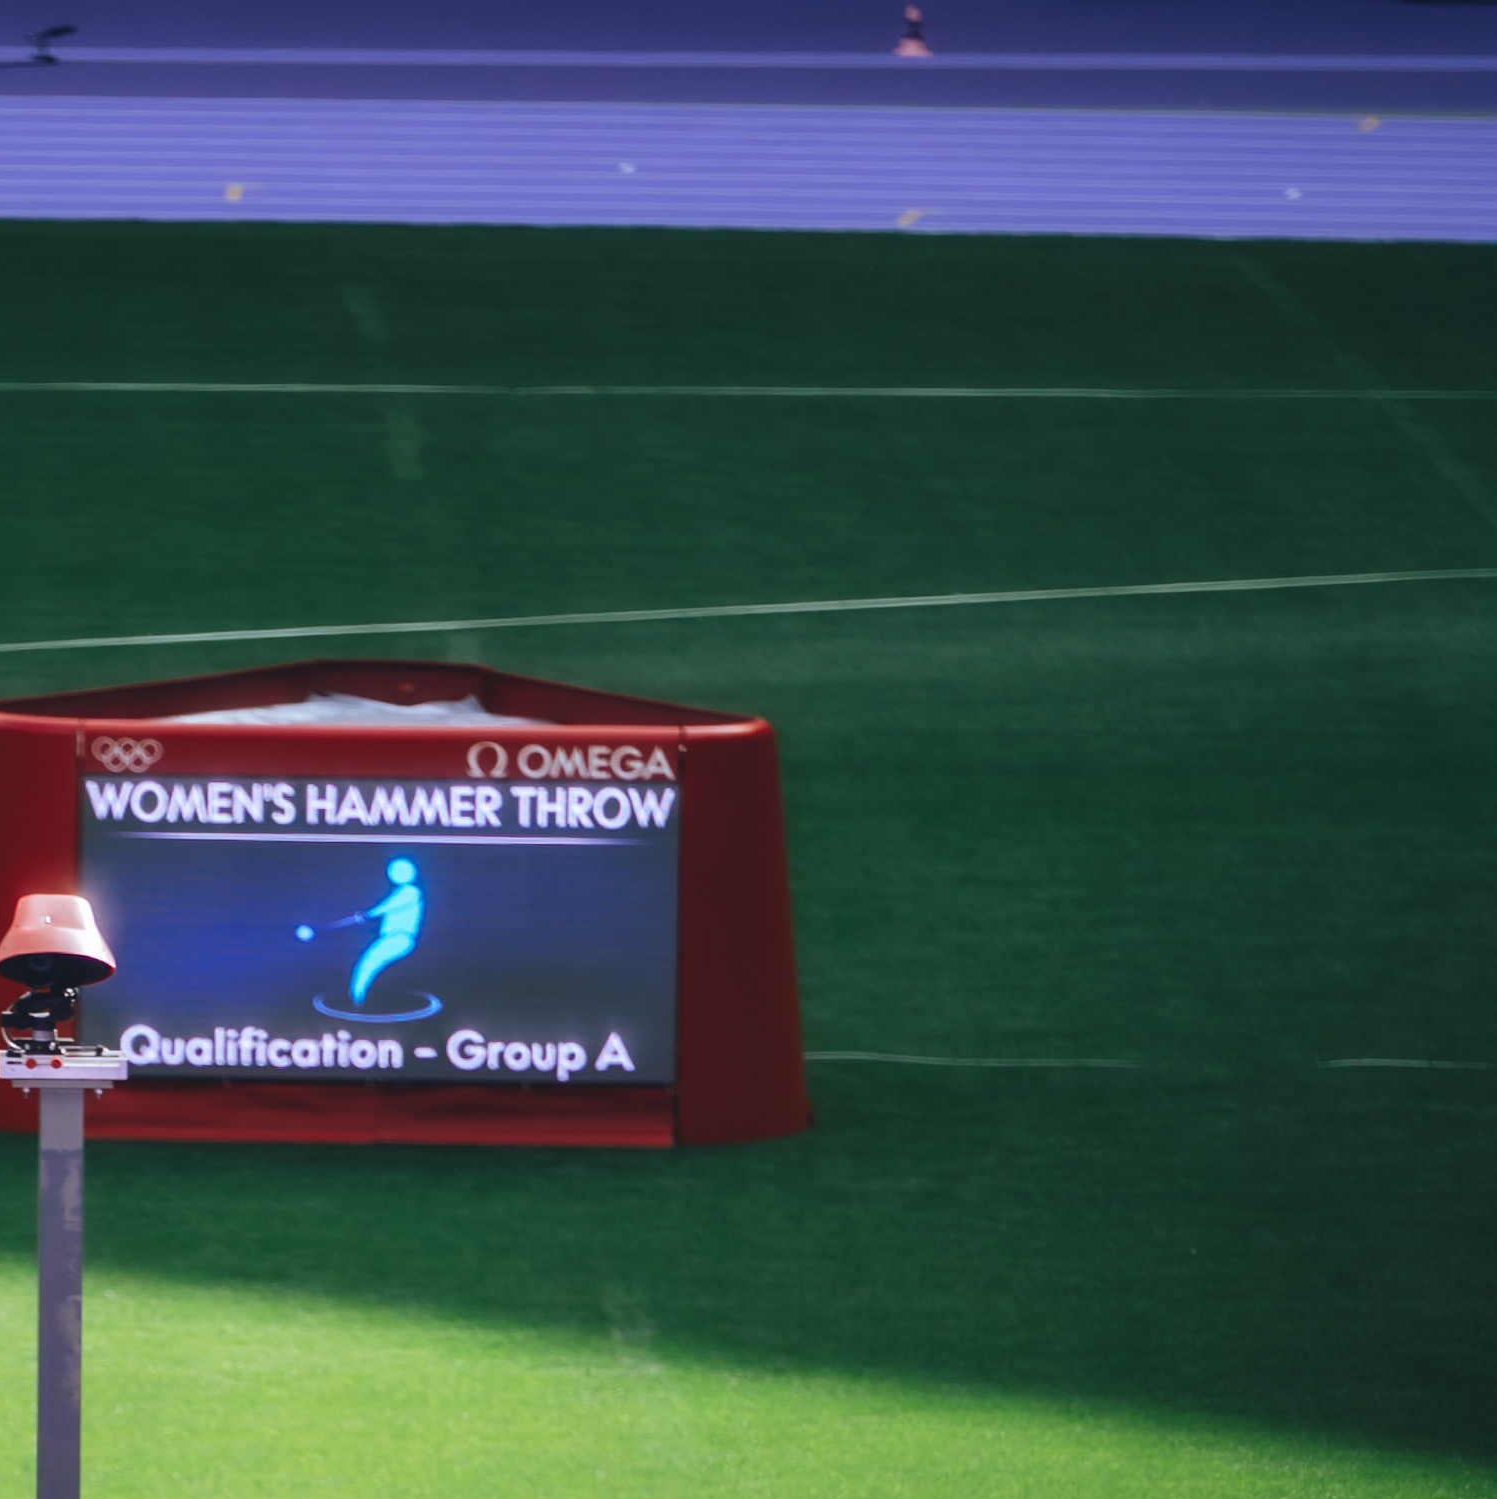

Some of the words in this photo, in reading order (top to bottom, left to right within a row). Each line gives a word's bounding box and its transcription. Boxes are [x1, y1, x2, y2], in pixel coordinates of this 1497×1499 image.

[518, 745, 675, 781] OMEGA
[86, 781, 296, 827] WOMEN'S
[305, 784, 502, 829] HAMMER
[510, 786, 675, 830] THROW
[121, 1024, 404, 1072] Qualification
[447, 1031, 587, 1083] Group
[595, 1033, 635, 1073] A
